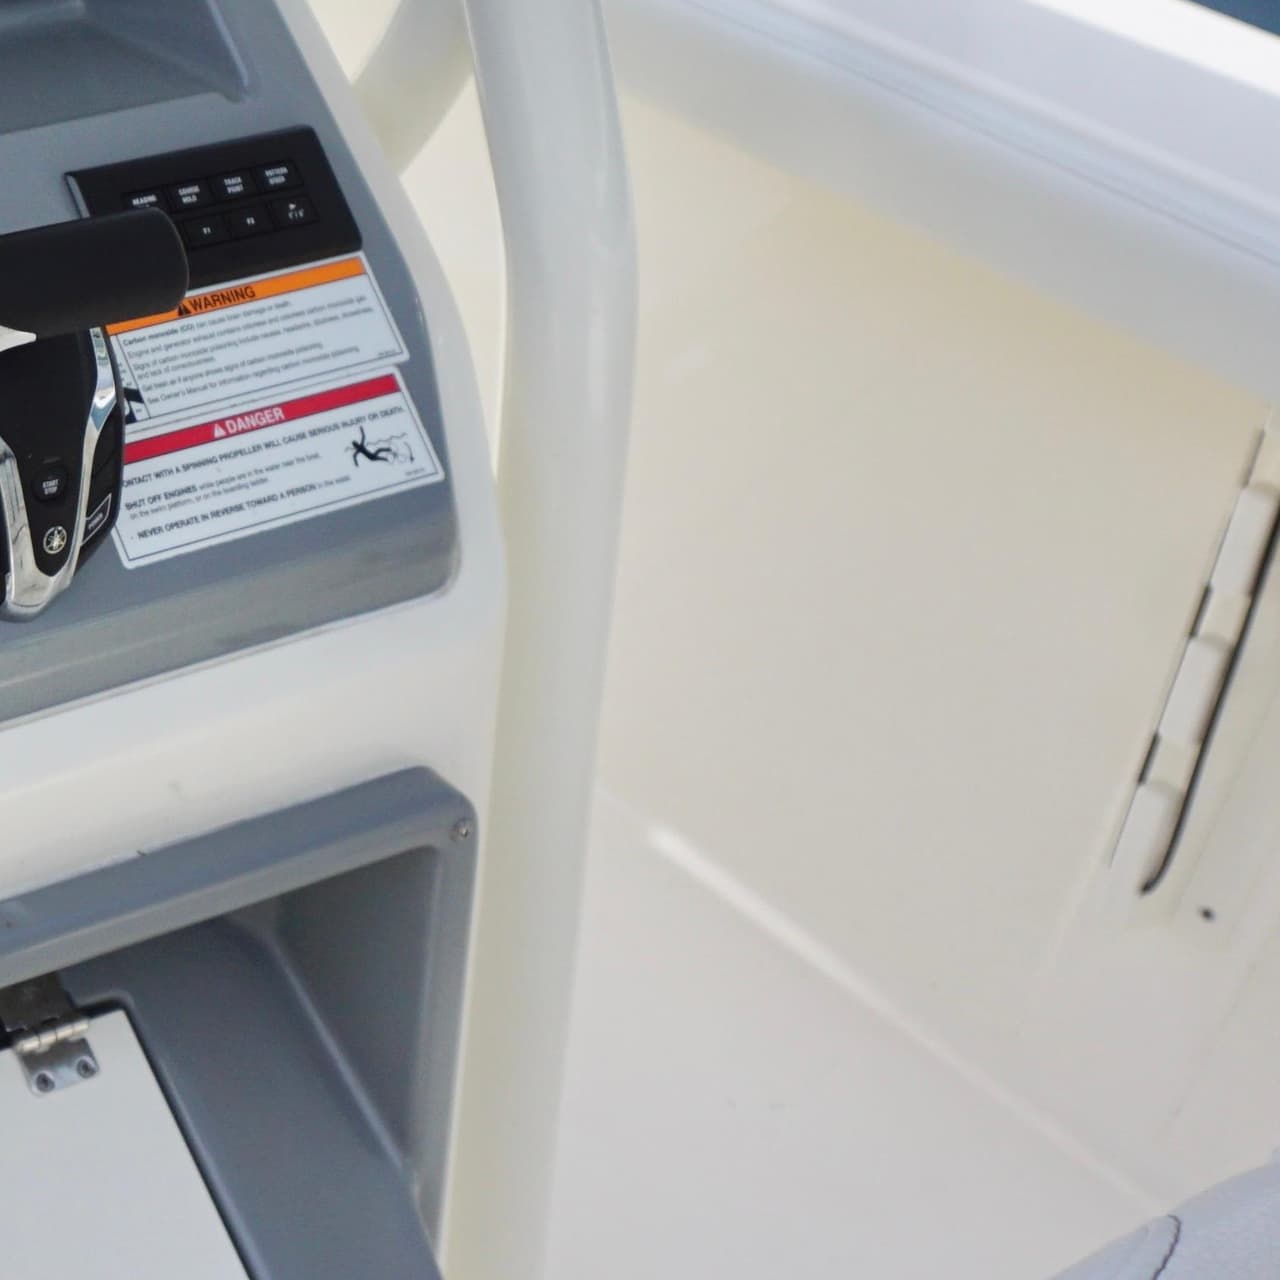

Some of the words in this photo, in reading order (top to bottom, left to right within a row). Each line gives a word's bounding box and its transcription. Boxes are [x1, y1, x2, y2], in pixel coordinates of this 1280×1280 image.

[190, 286, 256, 312] WARNING
[225, 407, 285, 434] DANGER
[122, 473, 152, 488] ONTACT
[153, 467, 174, 479] WITH
[173, 465, 181, 473] A
[181, 455, 218, 471] SPINNING
[218, 443, 263, 461] PROPELLER
[263, 438, 281, 449] WILL
[281, 431, 307, 444] CAUSE
[307, 421, 340, 437] SERIOUS
[340, 414, 367, 428] INJURY
[367, 411, 379, 421] OR
[146, 493, 162, 504] OFF
[162, 483, 197, 500] ENGINES
[136, 525, 162, 538] NEVER
[163, 515, 199, 531] OPERATE
[199, 512, 209, 521] IN
[209, 502, 245, 518] REVERSE
[244, 493, 278, 509] TOWARD
[278, 491, 287, 499] A
[286, 483, 316, 497] PERSON
